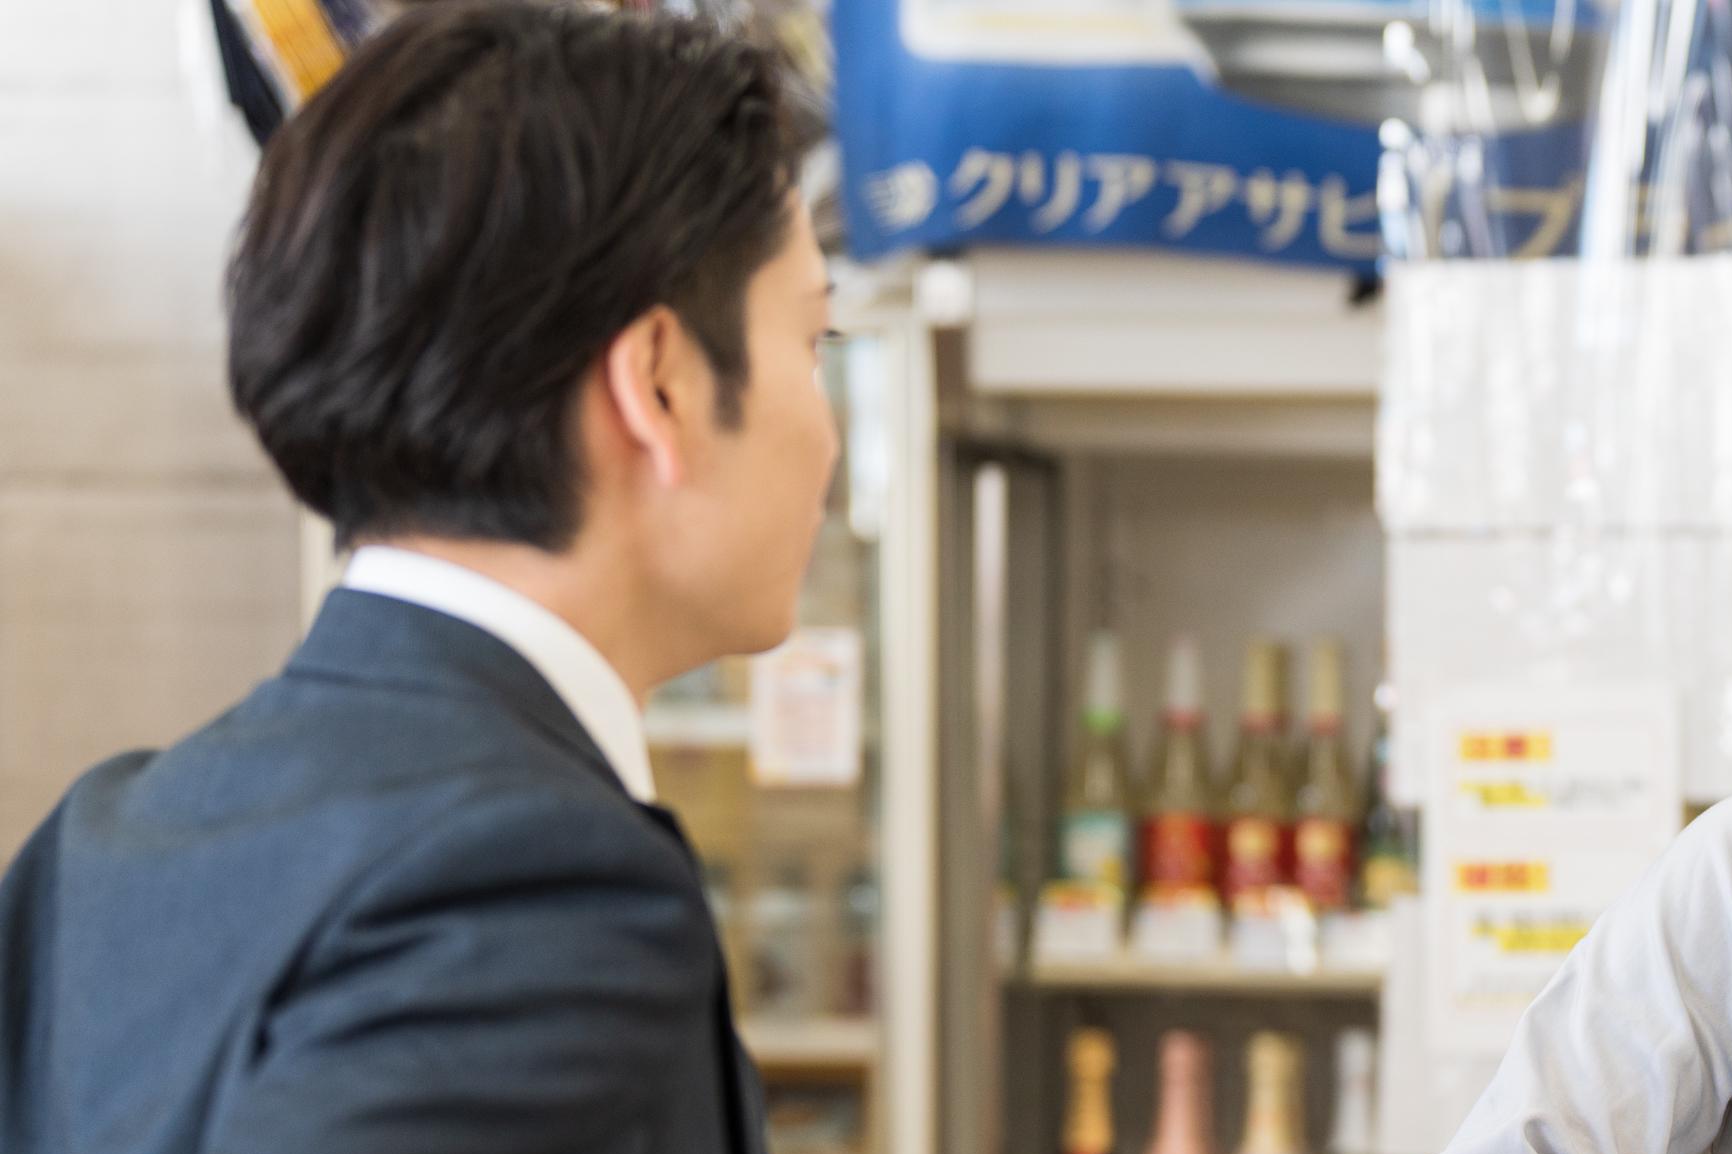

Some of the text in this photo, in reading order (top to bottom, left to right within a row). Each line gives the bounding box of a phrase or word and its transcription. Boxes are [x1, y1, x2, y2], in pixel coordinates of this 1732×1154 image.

[948, 147, 1378, 258] クリアアサヒ
